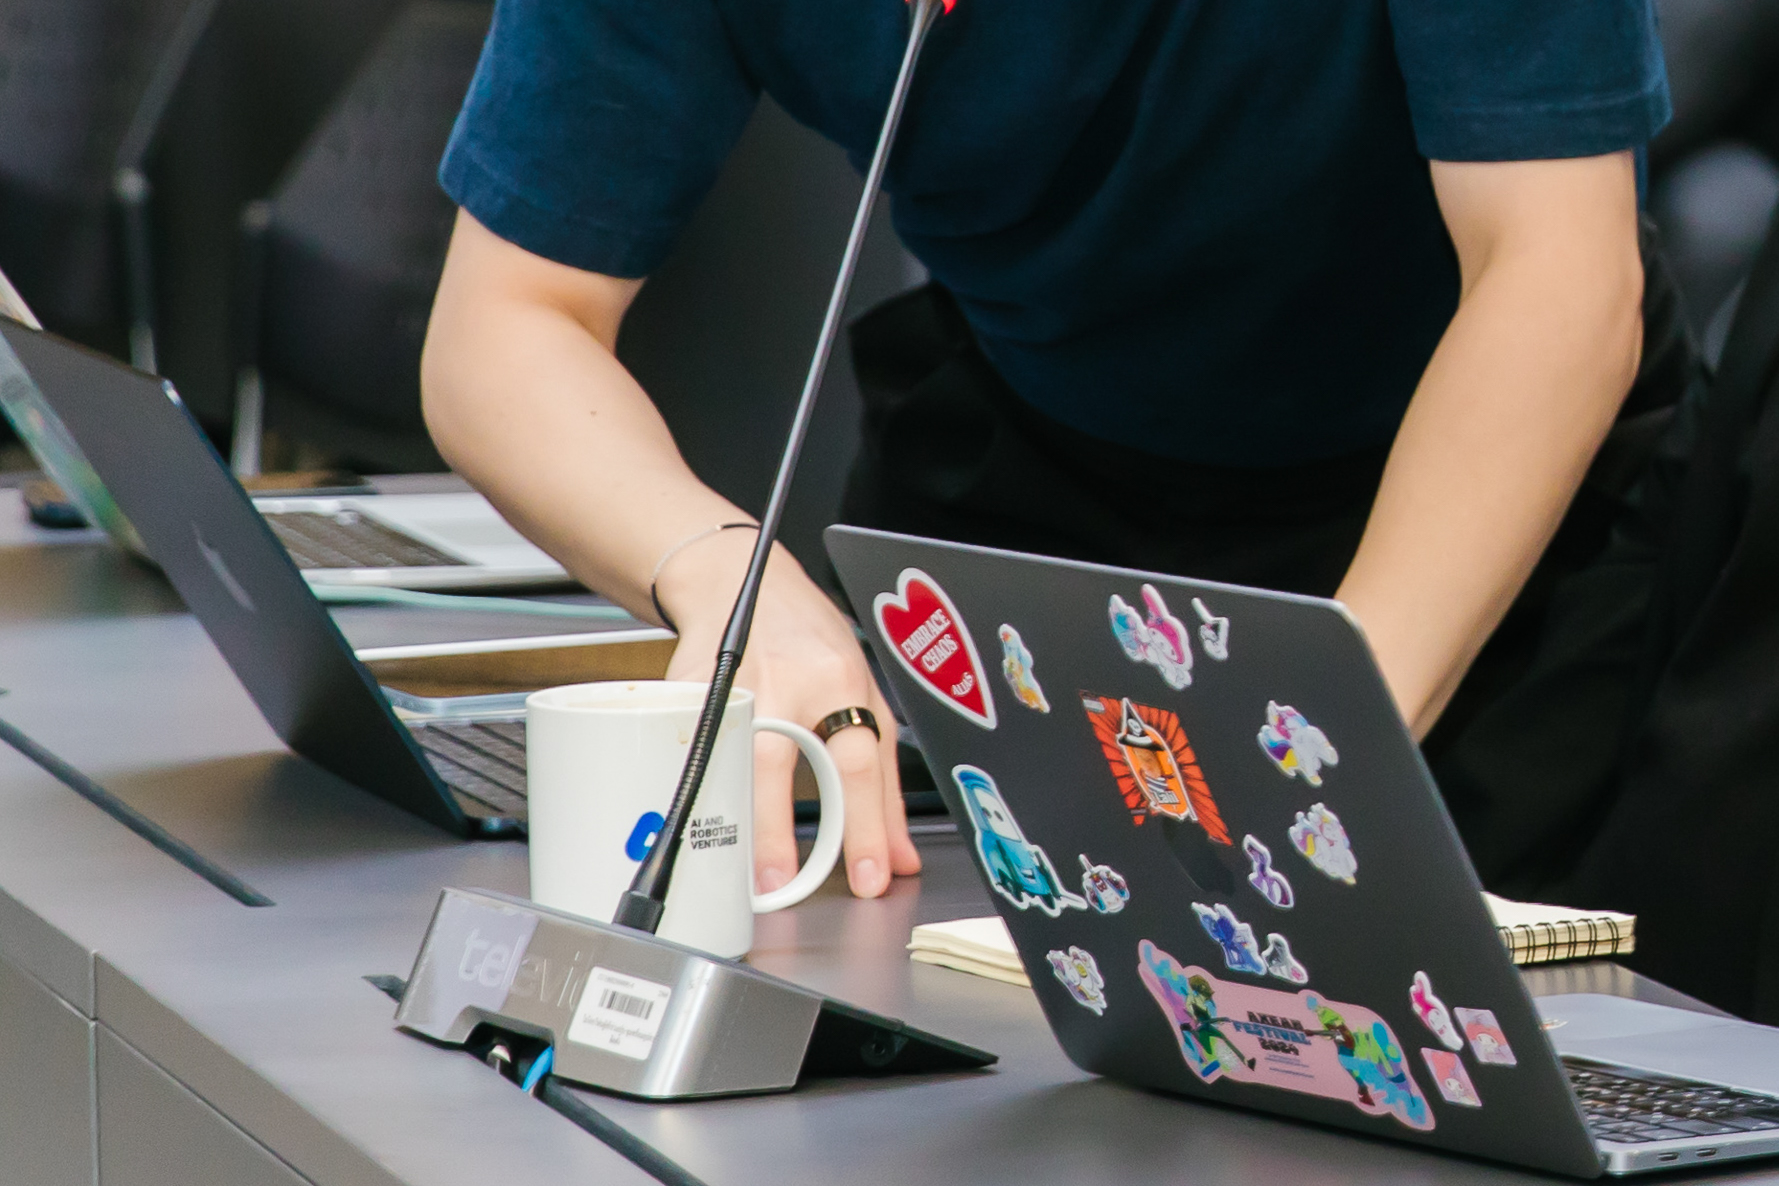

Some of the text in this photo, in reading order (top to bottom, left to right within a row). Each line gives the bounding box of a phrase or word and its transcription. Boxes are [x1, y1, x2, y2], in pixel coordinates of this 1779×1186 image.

[901, 608, 951, 660] EMBRACE
[922, 633, 958, 672] CHAOS
[690, 824, 738, 839] ROBOTICS
[691, 816, 723, 828] AI AND
[690, 835, 738, 850] VENTURES
[1232, 1020, 1312, 1046] FESTIVAL
[1257, 1037, 1300, 1056] 2024
